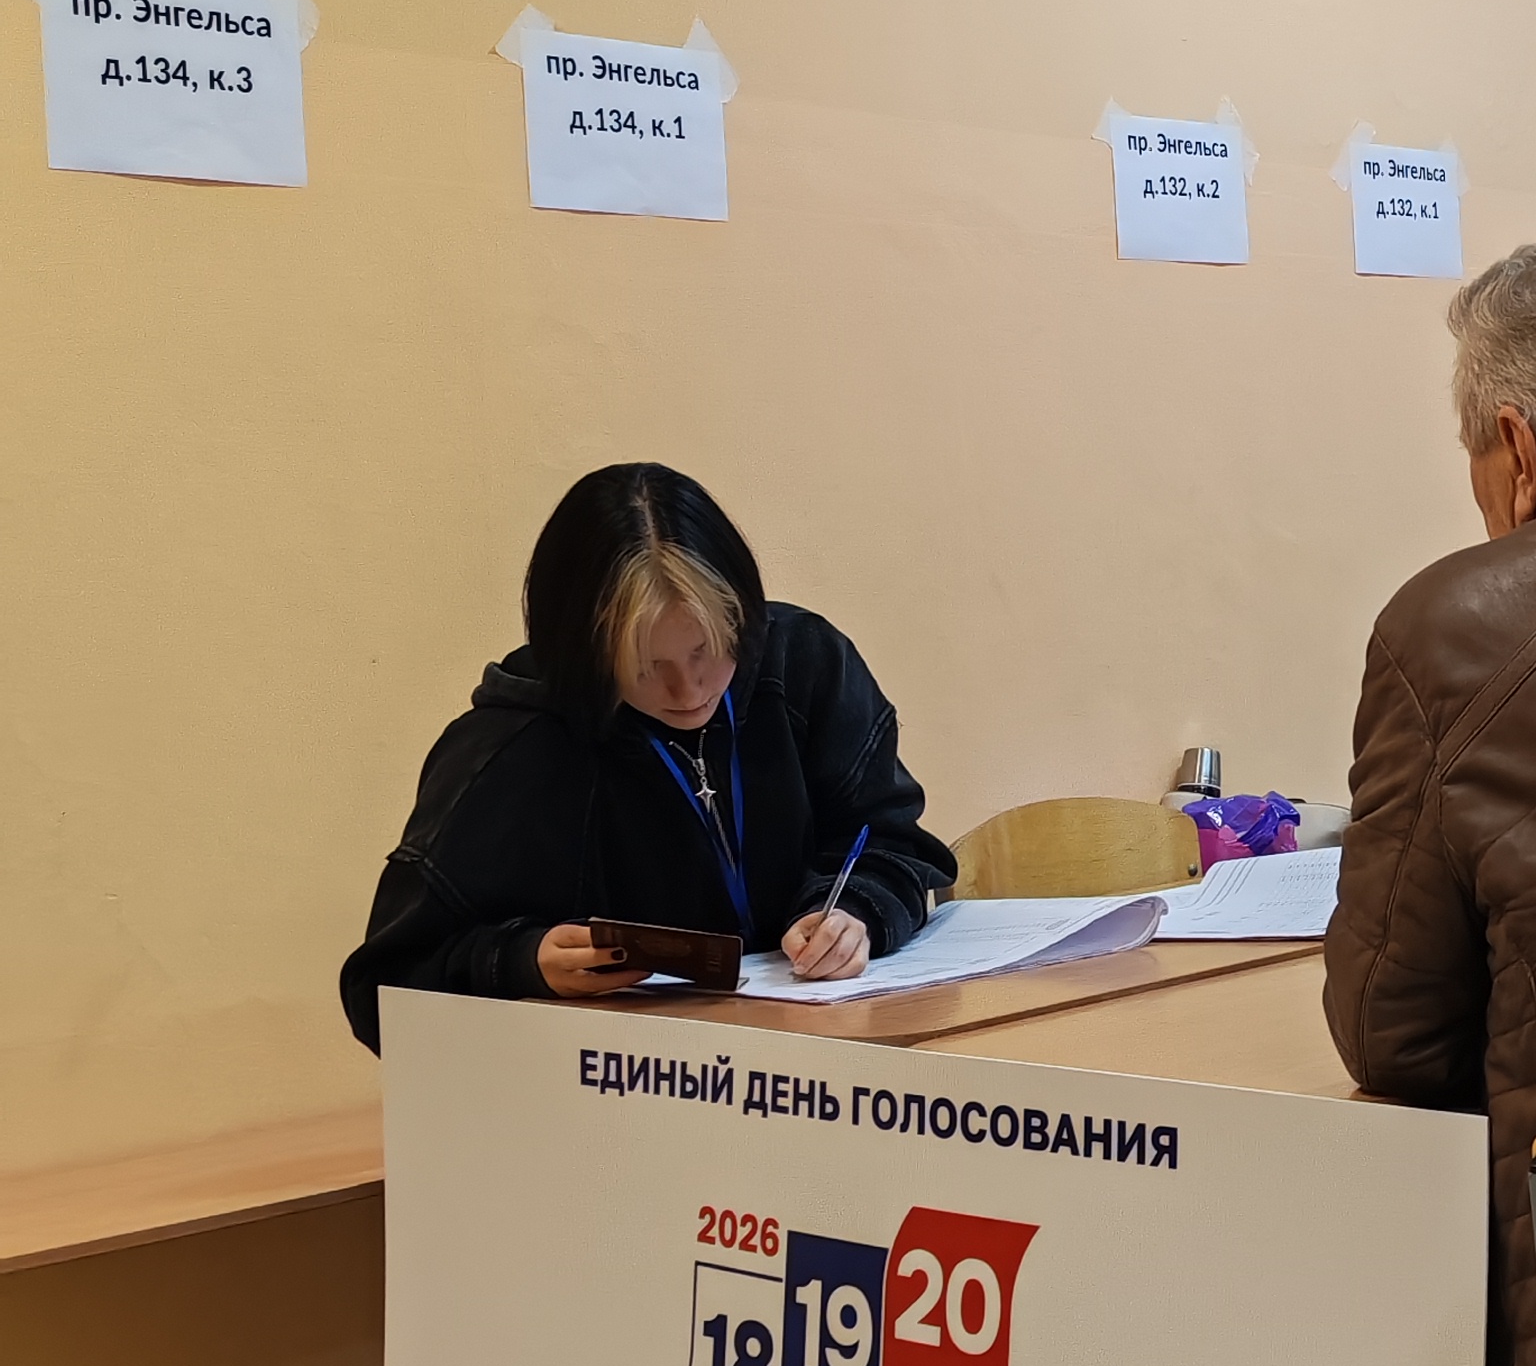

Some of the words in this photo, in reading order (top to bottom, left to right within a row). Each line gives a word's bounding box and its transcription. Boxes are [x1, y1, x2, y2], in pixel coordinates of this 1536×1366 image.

[100, 55, 198, 93] д.134,
[209, 66, 253, 94] к.3
[546, 55, 584, 81] пр.
[591, 54, 700, 91] Энгельса
[569, 107, 644, 140] д.134,
[651, 115, 686, 140] к.1
[1127, 134, 1153, 156] пр.
[1156, 133, 1228, 158] Энгельса
[1143, 175, 1192, 200] д.132,
[1196, 179, 1220, 199] к.2
[1363, 160, 1385, 180] пр.
[1388, 159, 1446, 183] Энгельса
[1376, 197, 1417, 220] д.132,
[1420, 201, 1440, 220] к.1
[579, 1048, 735, 1106] ЕДИНЫЙ
[742, 1070, 841, 1122] ДЕНЬ
[851, 1085, 1178, 1170] ГОЛОСОВАНИЯ
[696, 1205, 780, 1257] 2026
[893, 1247, 1002, 1356] 20
